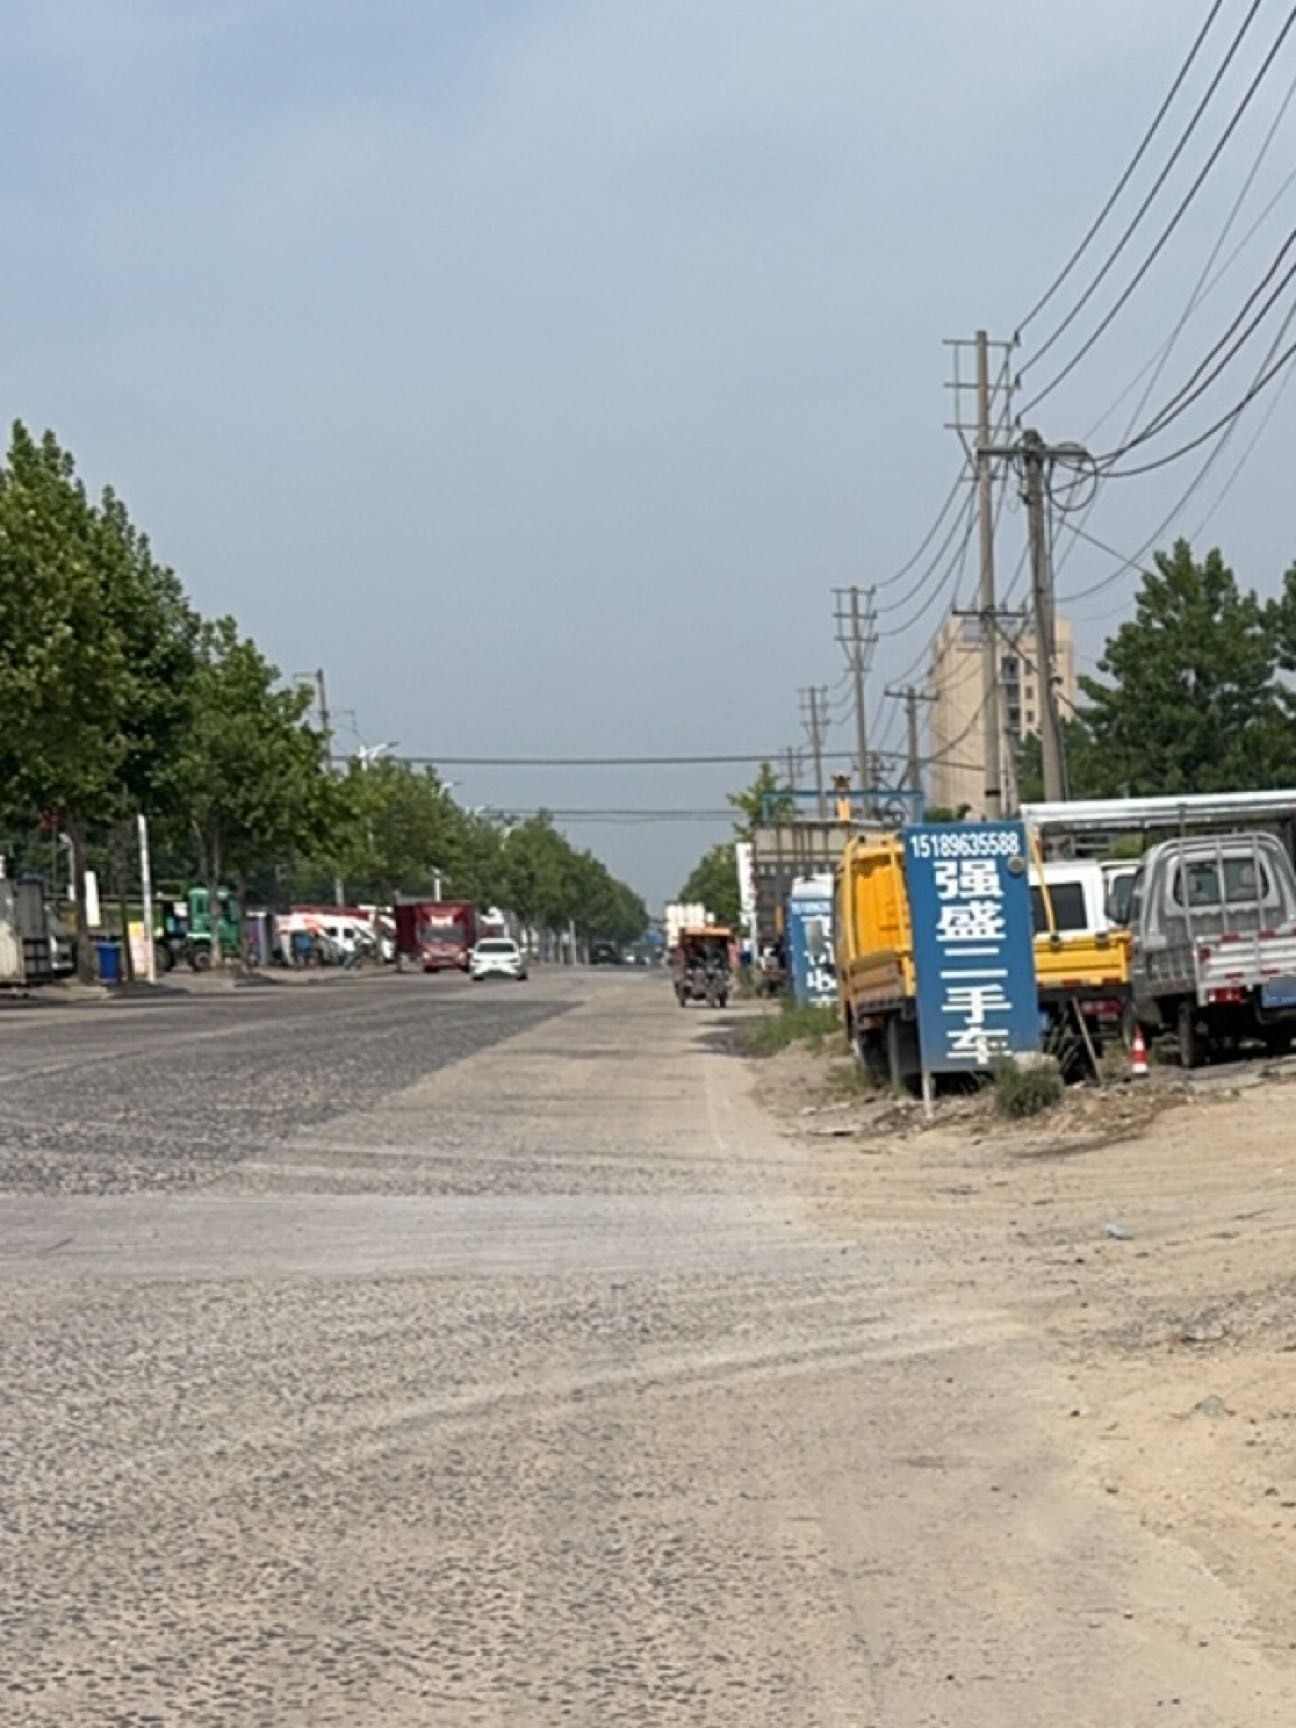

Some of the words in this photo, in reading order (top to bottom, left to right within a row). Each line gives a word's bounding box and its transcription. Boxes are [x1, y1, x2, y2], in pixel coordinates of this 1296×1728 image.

[910, 831, 1020, 858] 15189635588
[933, 858, 1013, 1065] 强盛二手车
